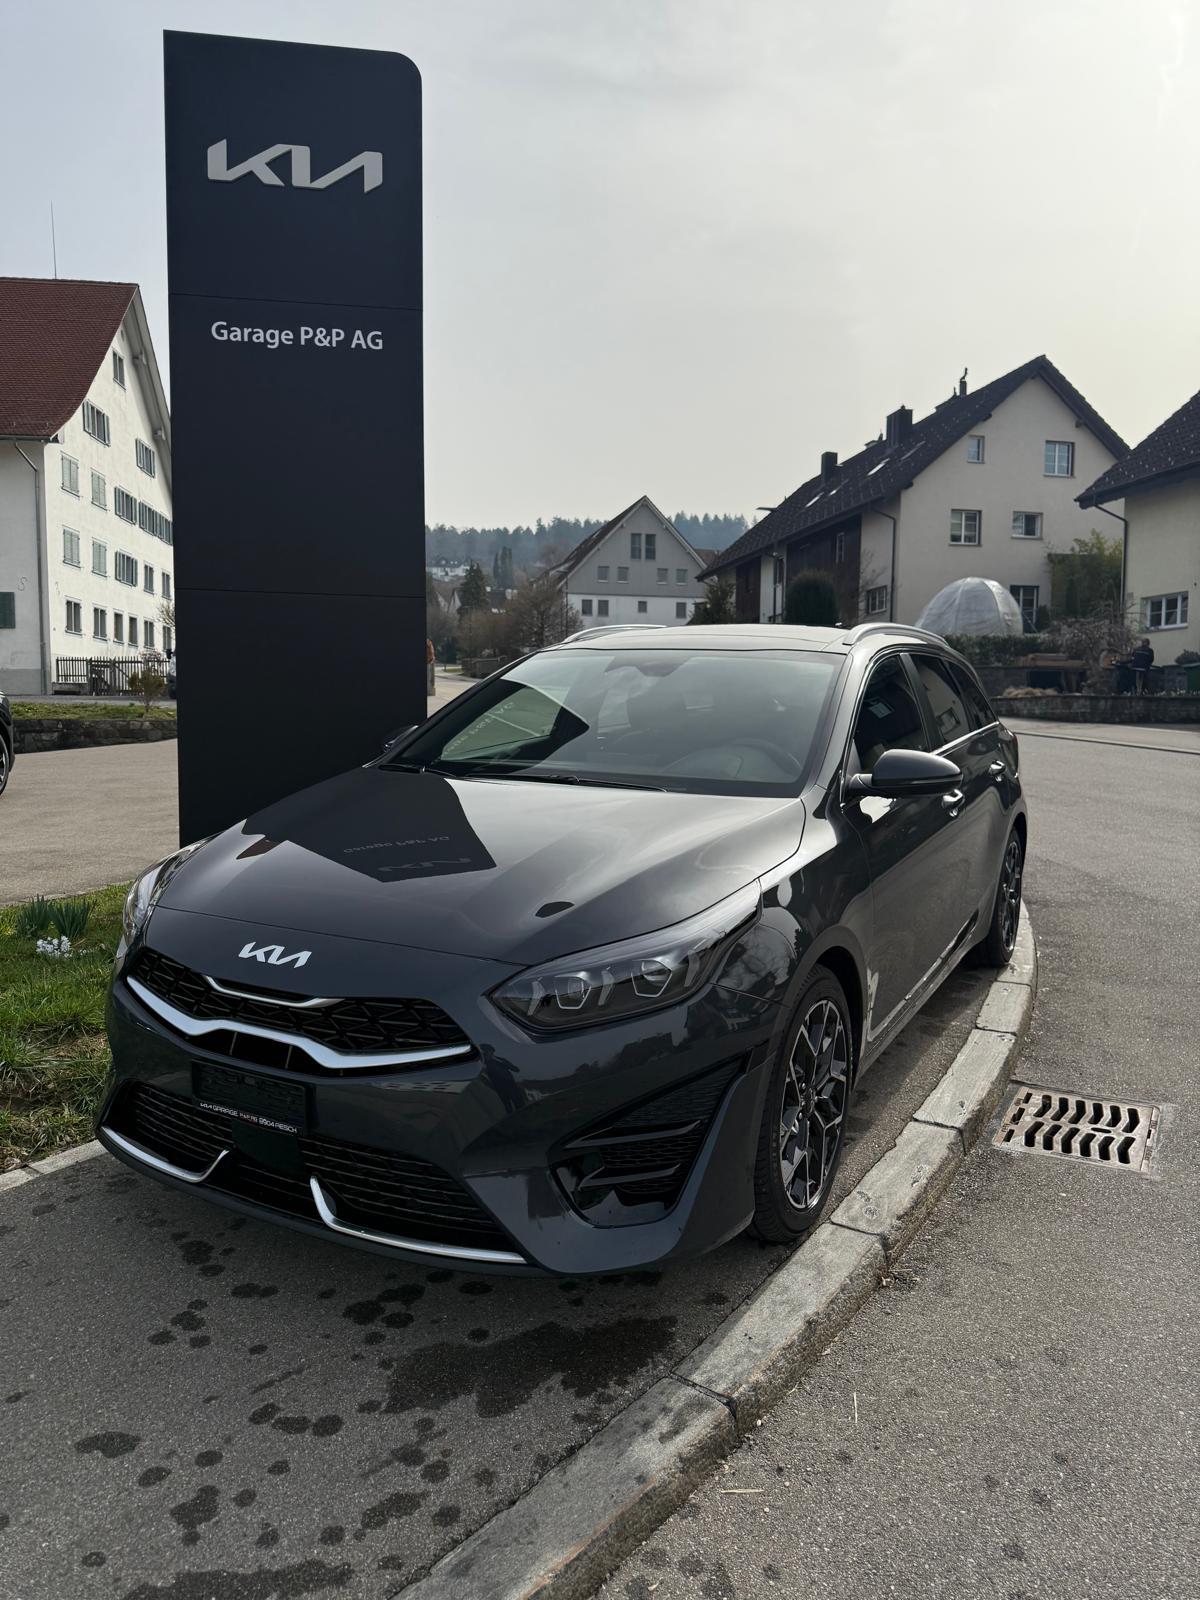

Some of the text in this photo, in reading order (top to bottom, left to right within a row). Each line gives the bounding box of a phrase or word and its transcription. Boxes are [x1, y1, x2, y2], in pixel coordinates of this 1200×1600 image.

[207, 138, 383, 194] KIA
[211, 321, 383, 350] Garage P&P AG
[238, 941, 313, 969] KIA
